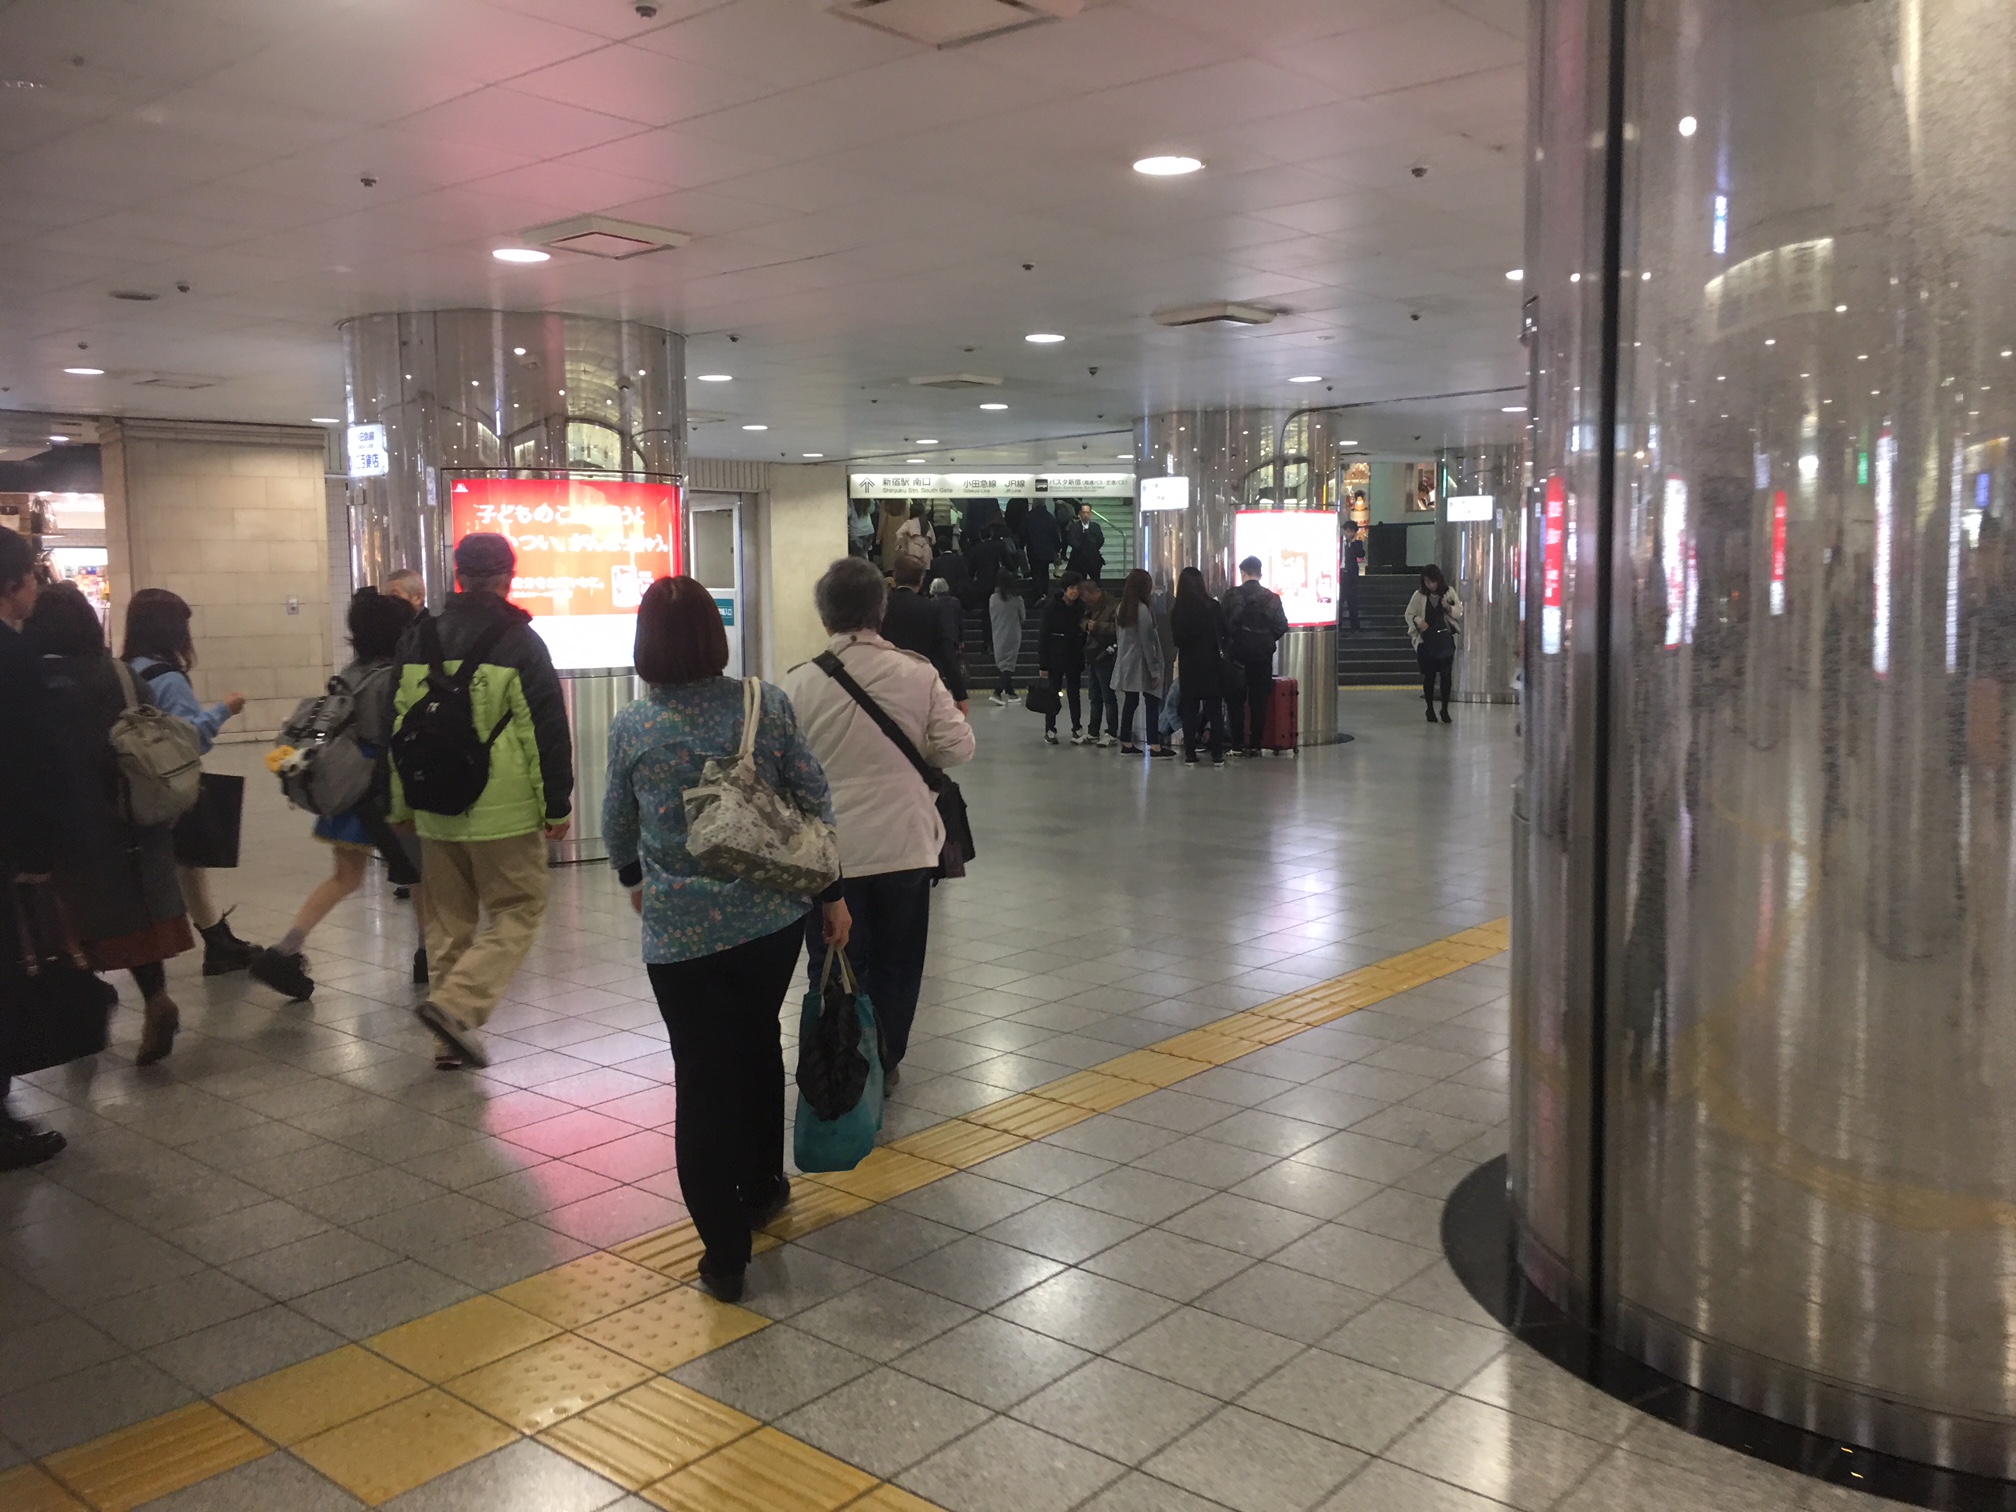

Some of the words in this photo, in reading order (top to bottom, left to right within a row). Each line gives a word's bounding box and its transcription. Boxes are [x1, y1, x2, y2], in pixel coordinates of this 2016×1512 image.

[882, 477, 910, 487] 新宿駅
[913, 477, 931, 486] 南口
[963, 479, 997, 488] 小田急線
[1005, 479, 1025, 488] JR線
